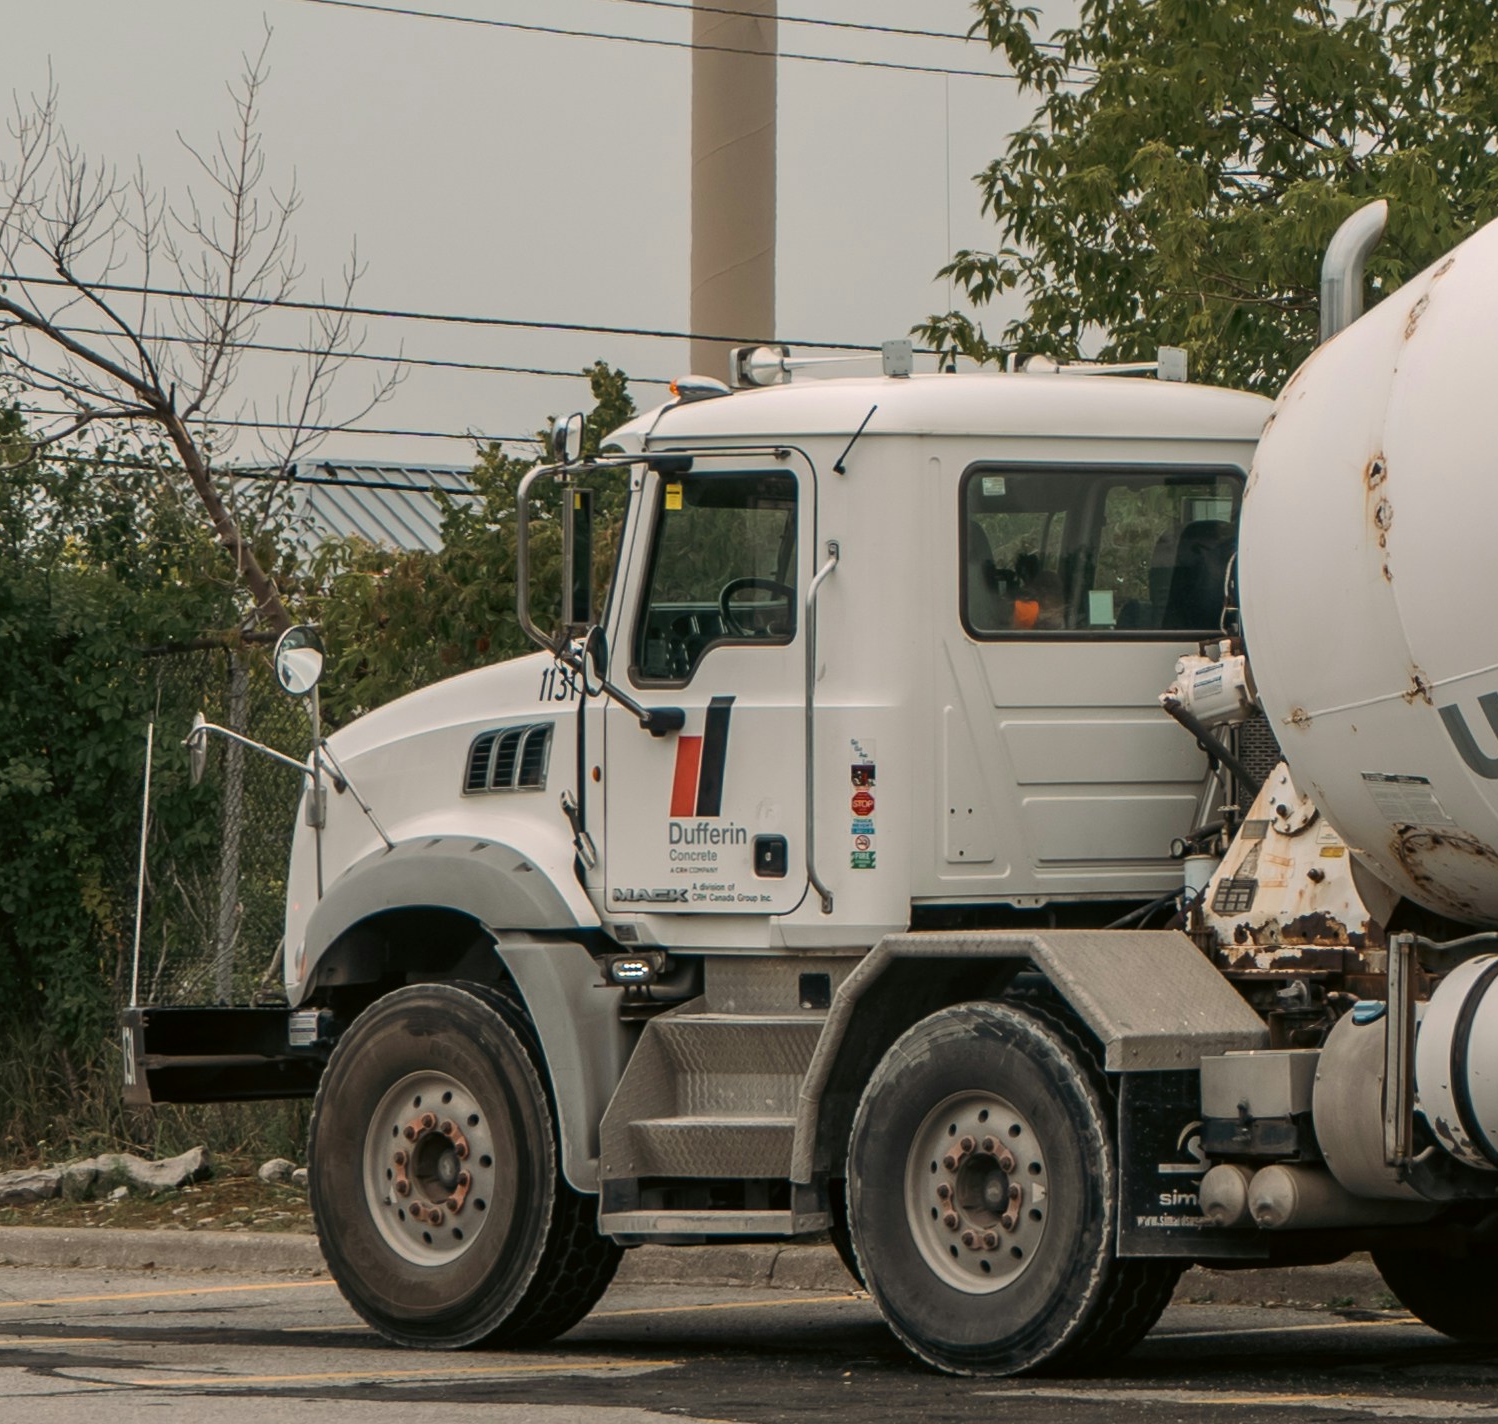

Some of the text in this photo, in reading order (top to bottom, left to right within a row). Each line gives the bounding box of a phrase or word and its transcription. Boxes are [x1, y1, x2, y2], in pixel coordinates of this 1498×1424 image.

[853, 800, 873, 808] STOP
[669, 822, 747, 845] Dufferin
[669, 848, 718, 862] Concrete
[699, 883, 725, 891] division
[727, 883, 735, 891] of
[613, 888, 689, 903] MACK
[709, 893, 735, 902] Canada
[737, 893, 758, 903] Group
[760, 894, 773, 902] Inc.
[1159, 1188, 1200, 1206] sim
